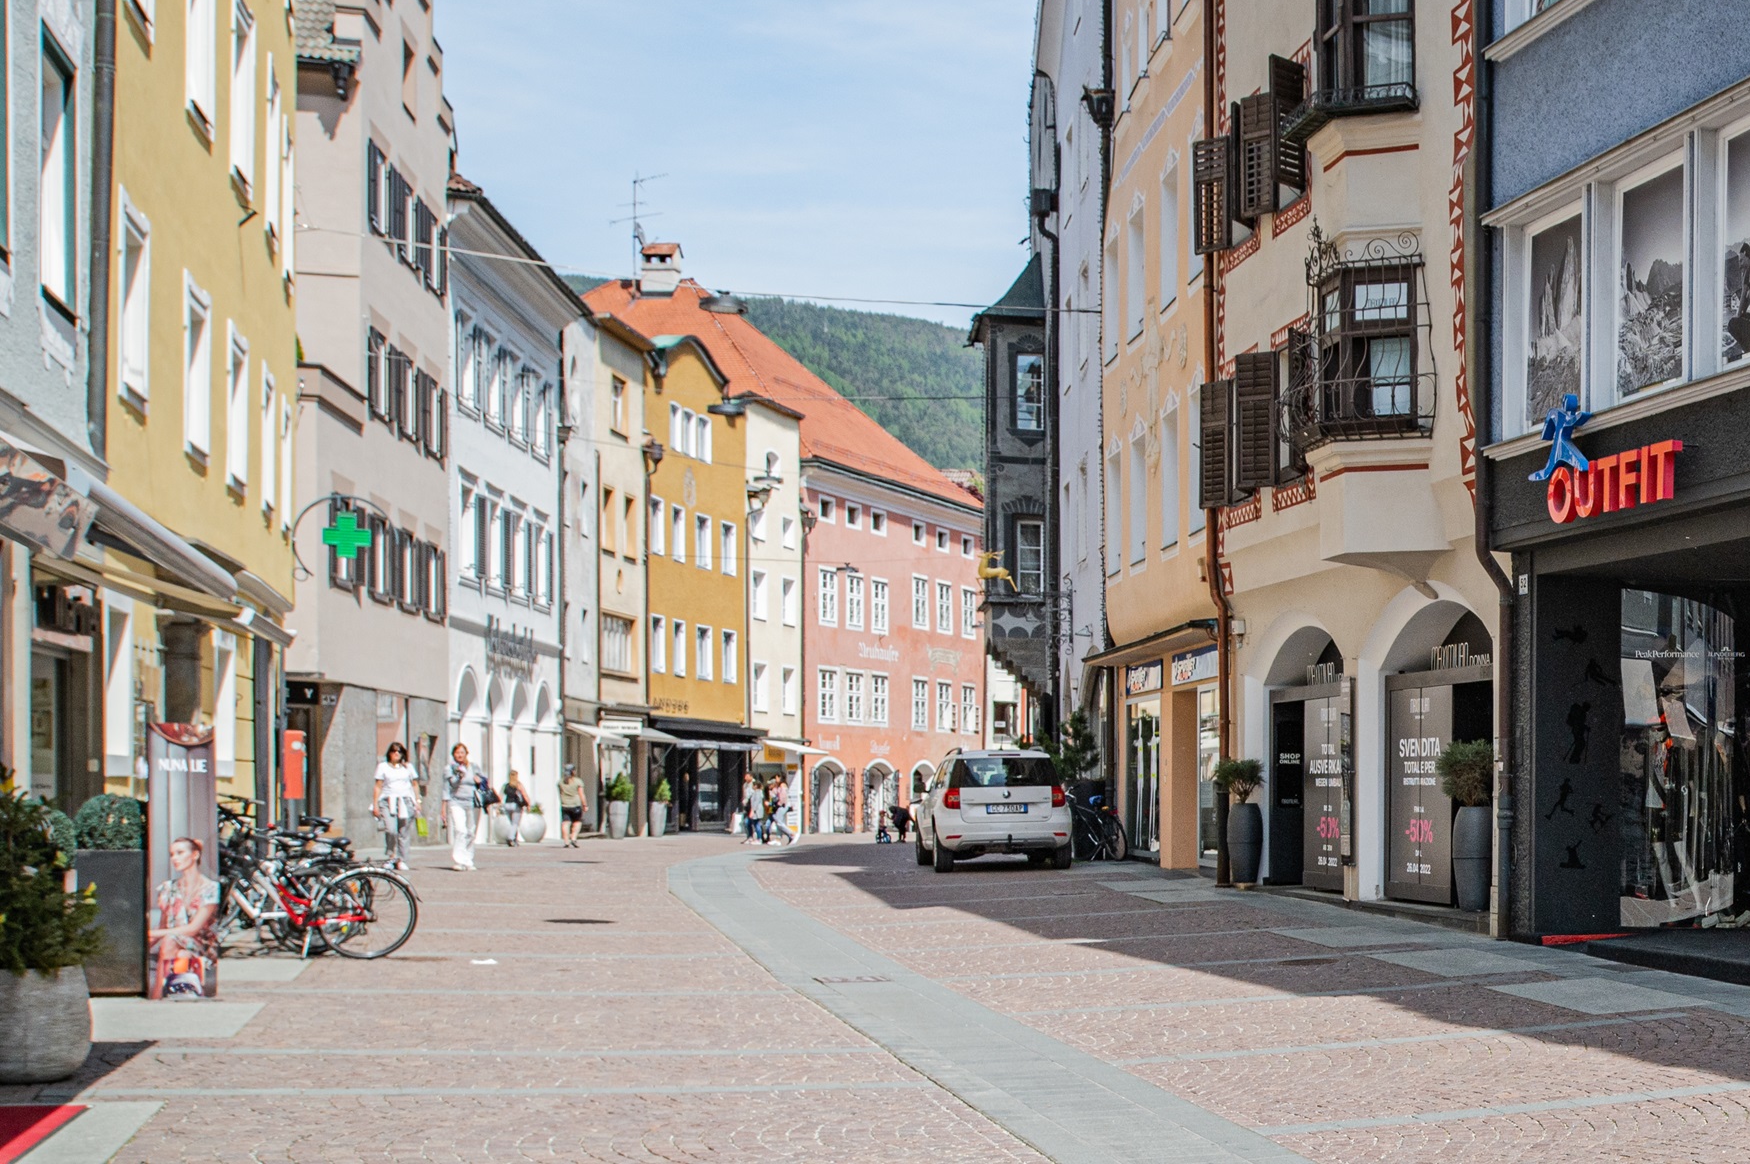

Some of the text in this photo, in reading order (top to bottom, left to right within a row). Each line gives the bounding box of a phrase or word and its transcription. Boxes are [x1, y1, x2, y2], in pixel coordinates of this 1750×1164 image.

[1547, 439, 1683, 524] OUTFIT
[1469, 653, 1491, 666] DONNA
[1399, 737, 1441, 757] SVENDITA
[1317, 816, 1340, 839] -50%
[1405, 819, 1433, 844] -50%
